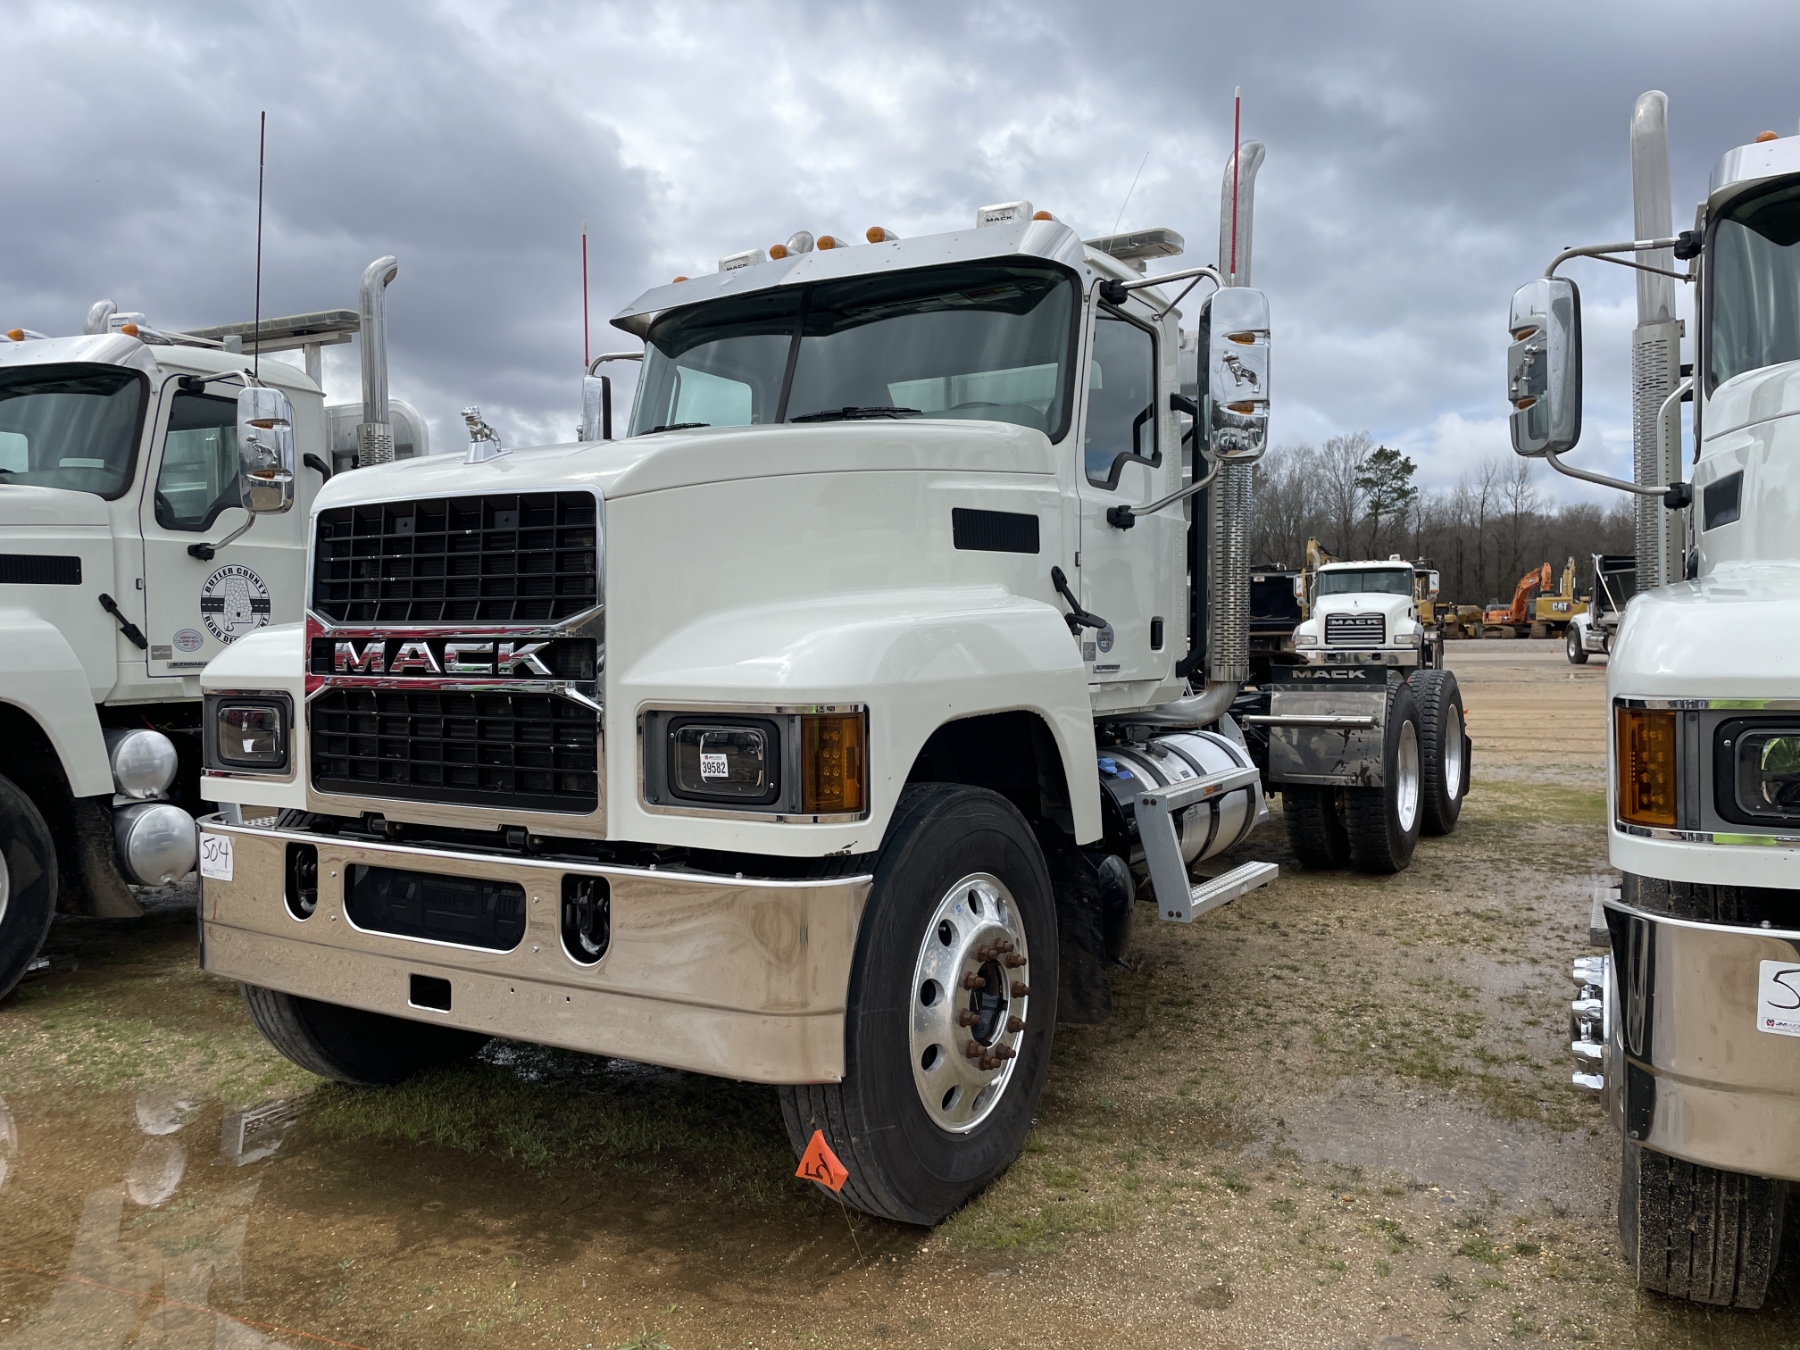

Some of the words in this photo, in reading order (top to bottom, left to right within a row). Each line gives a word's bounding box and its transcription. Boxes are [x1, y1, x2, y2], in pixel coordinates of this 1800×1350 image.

[986, 215, 1013, 223] MACK
[726, 262, 749, 271] MACK
[204, 567, 234, 594] BUTLER
[236, 567, 267, 595] COUNTY
[1552, 602, 1568, 611] CAT
[204, 615, 222, 638] ROAD
[334, 641, 552, 675] MACK
[1292, 669, 1366, 679] MACK
[702, 761, 726, 774] 39582
[203, 837, 229, 869] 504
